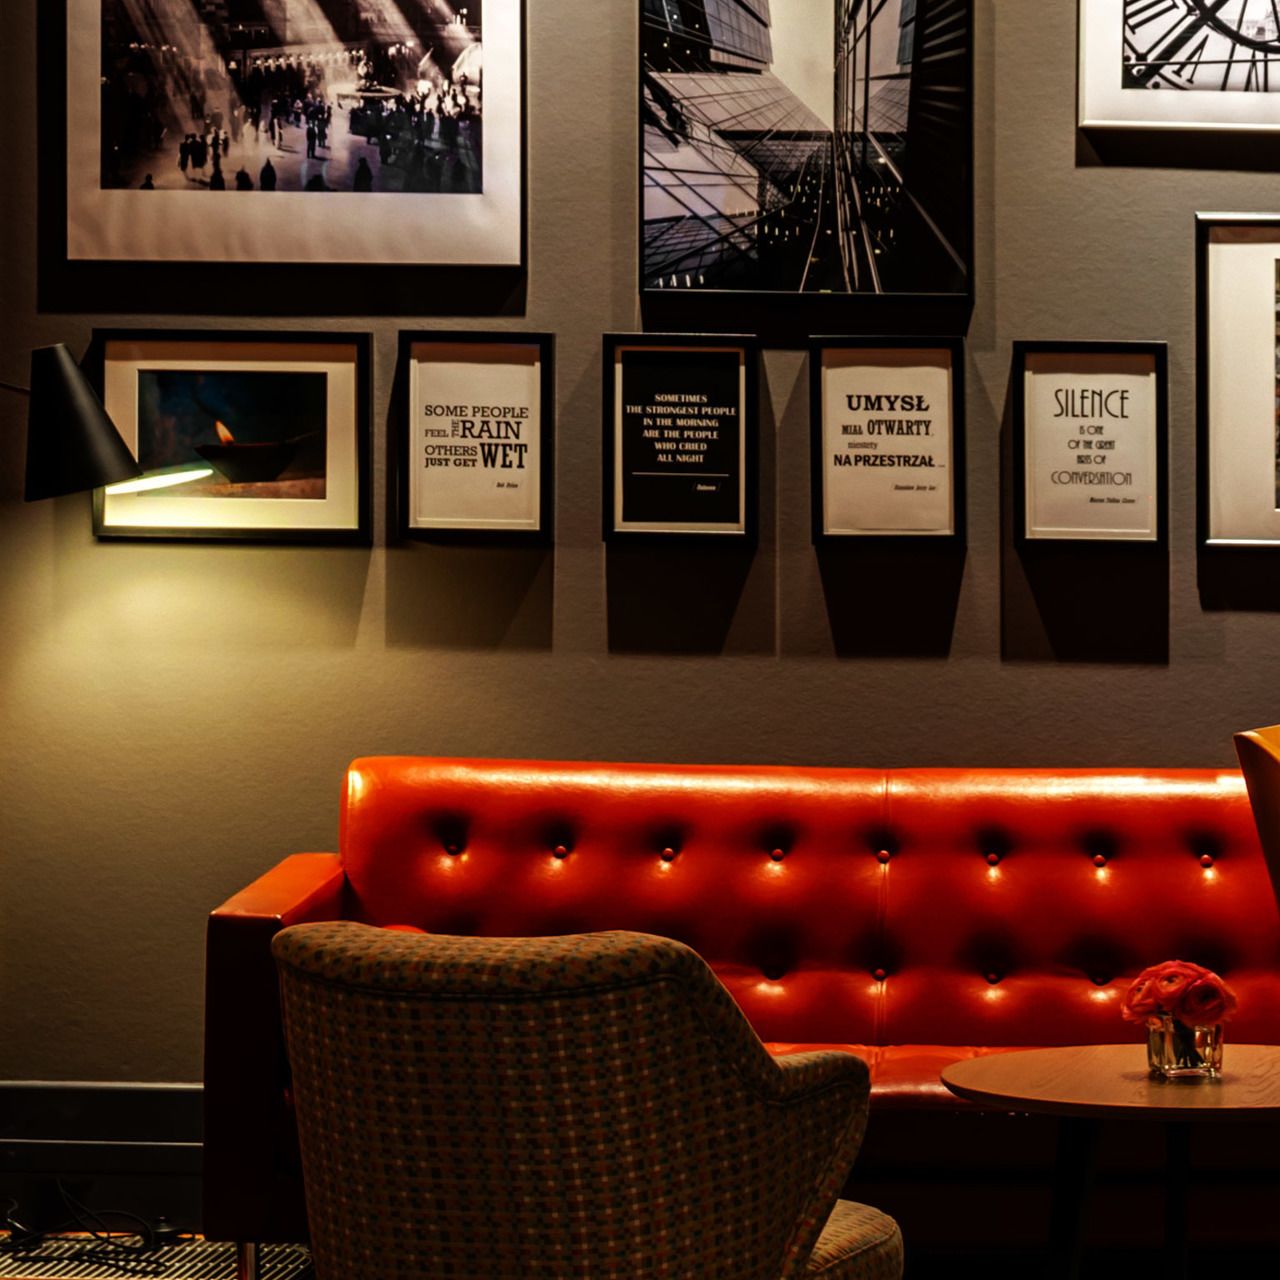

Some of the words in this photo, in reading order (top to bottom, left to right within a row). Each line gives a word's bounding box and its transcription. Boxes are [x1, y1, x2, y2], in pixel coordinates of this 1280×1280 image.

[655, 394, 708, 403] SOMETIMES
[846, 395, 930, 411] UMYSŁ
[1054, 389, 1129, 418] SILENCE
[424, 405, 469, 417] SOME
[472, 406, 529, 419] PEOPLE
[626, 405, 643, 414] THE
[646, 405, 699, 415] STRONGEST
[701, 407, 736, 416] PEOPLE
[643, 418, 653, 426] IN
[656, 418, 673, 426] THE
[676, 418, 719, 427] MORNING
[424, 429, 449, 438] FEEL
[451, 419, 459, 438] THE
[460, 419, 523, 440] RAIN
[642, 429, 660, 438] ARE
[664, 430, 680, 438] THE
[683, 430, 719, 439] PEOPLE
[1080, 426, 1085, 435] IS
[654, 442, 676, 450] WHO
[679, 442, 707, 451] CRIED
[1068, 440, 1080, 449] OF
[424, 445, 478, 456] OTHERS
[424, 458, 450, 468] JUST
[453, 458, 478, 467] GET
[479, 442, 528, 468] WET
[657, 454, 674, 462] ALL
[676, 454, 704, 463] NIGHT
[834, 454, 852, 466] NA
[1093, 455, 1106, 464] OF
[1051, 471, 1132, 486] CONVERSATION
